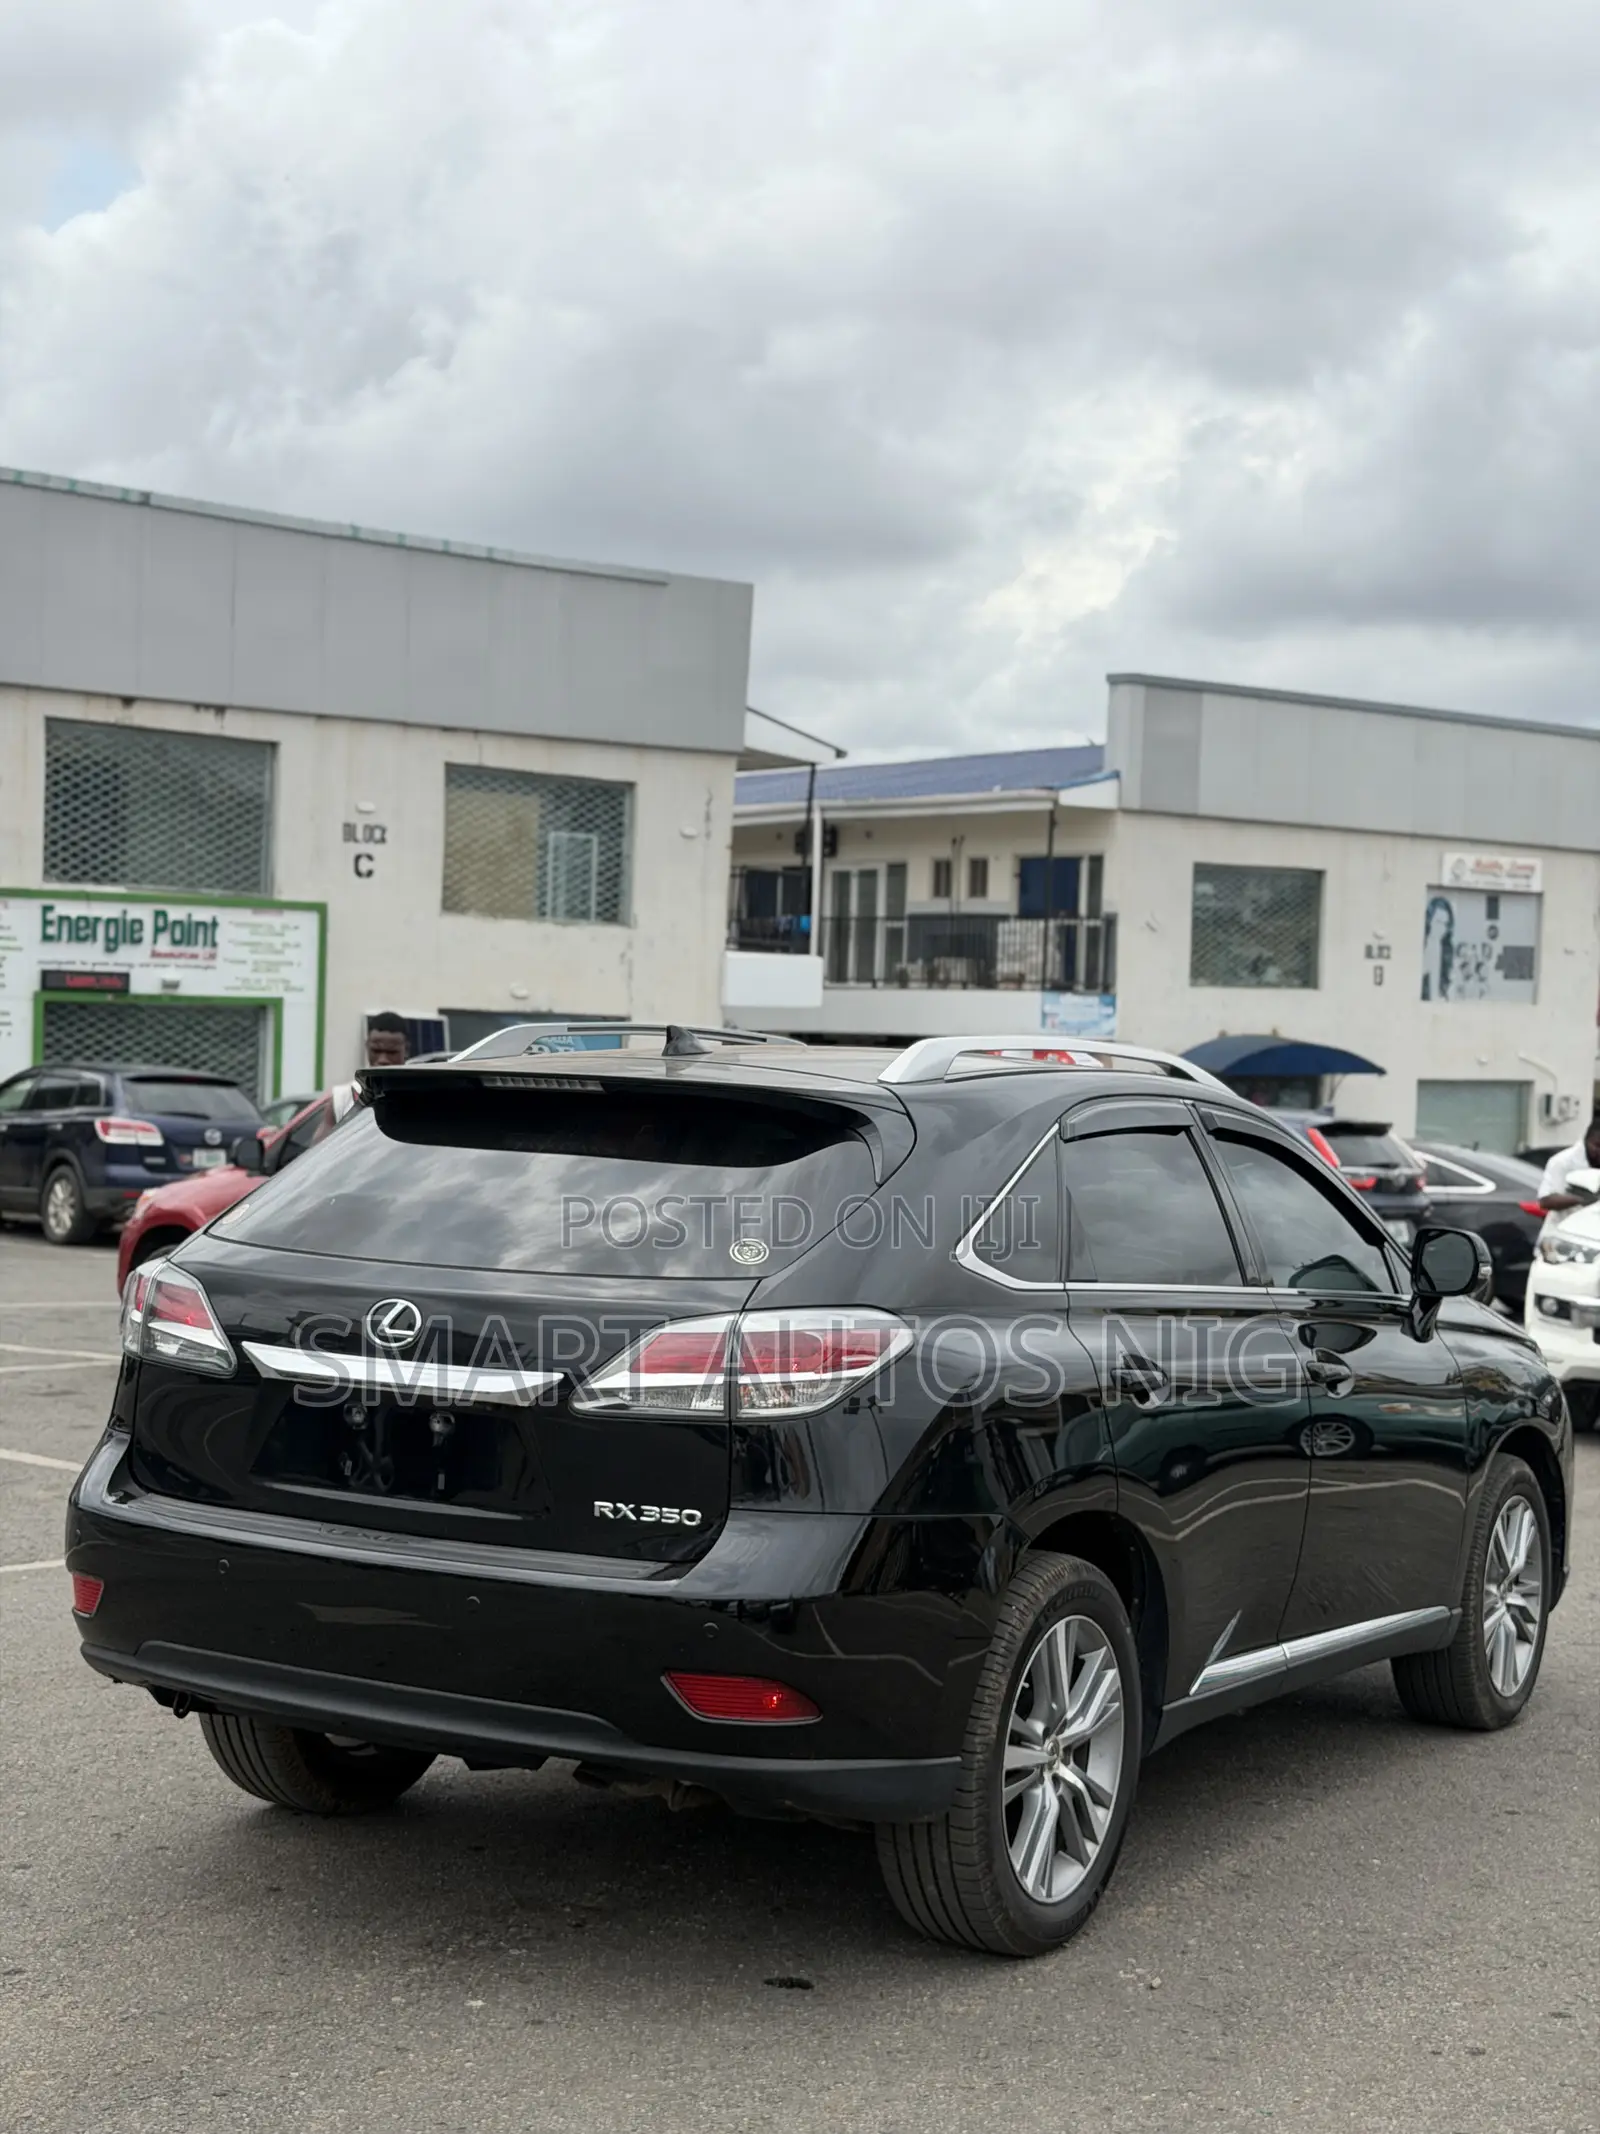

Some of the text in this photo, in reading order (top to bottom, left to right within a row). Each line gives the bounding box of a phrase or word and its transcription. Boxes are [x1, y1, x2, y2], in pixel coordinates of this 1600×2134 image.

[354, 853, 374, 878] C
[41, 904, 144, 953] Energie
[152, 909, 219, 947] Point
